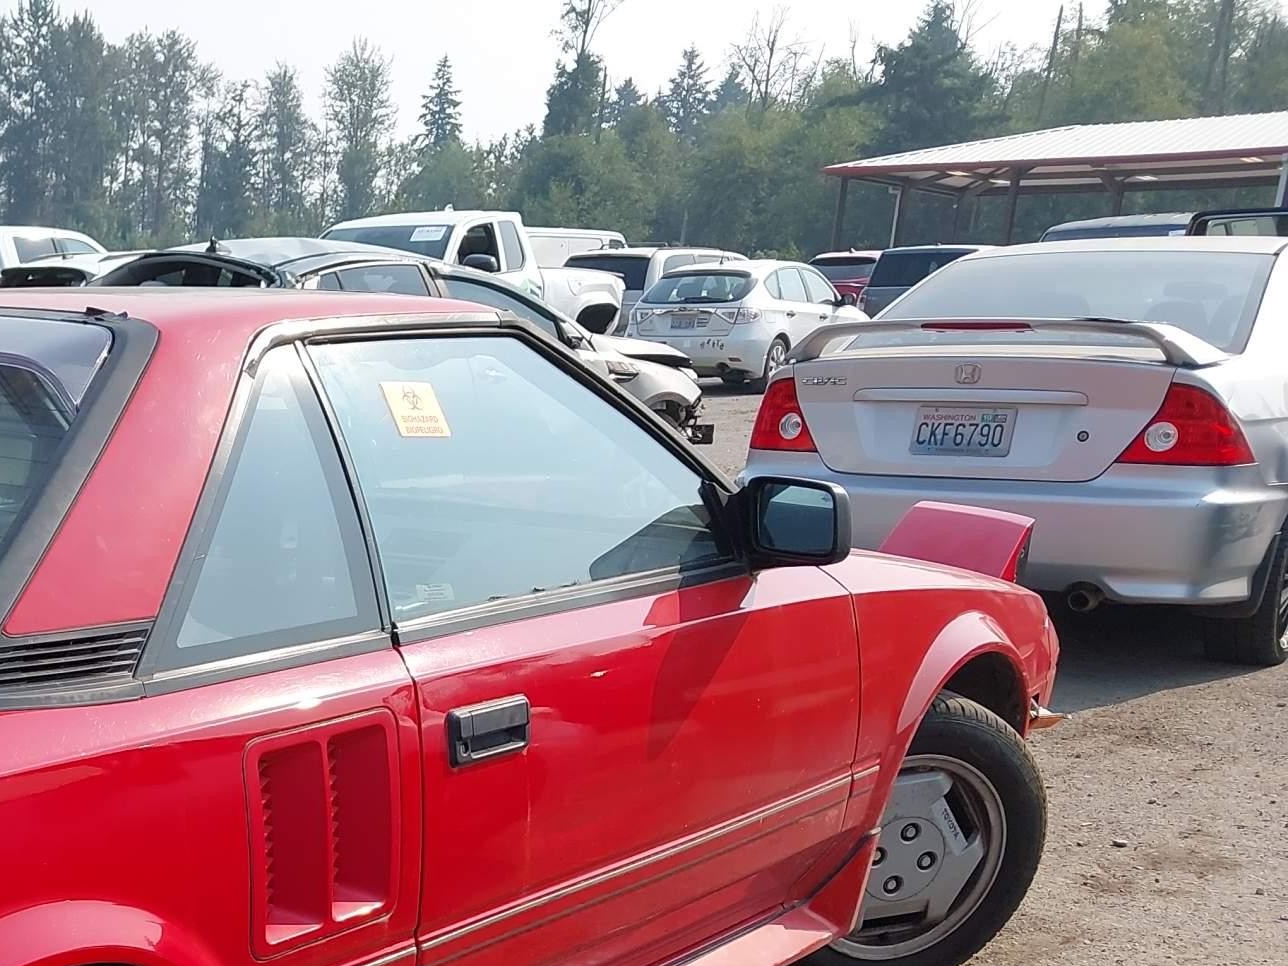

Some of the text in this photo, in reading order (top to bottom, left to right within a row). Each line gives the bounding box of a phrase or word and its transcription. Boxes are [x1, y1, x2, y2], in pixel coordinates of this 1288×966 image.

[401, 415, 439, 424] BIOHAZARD
[923, 413, 977, 422] WASHINGTON
[915, 422, 1005, 448] CKF6790
